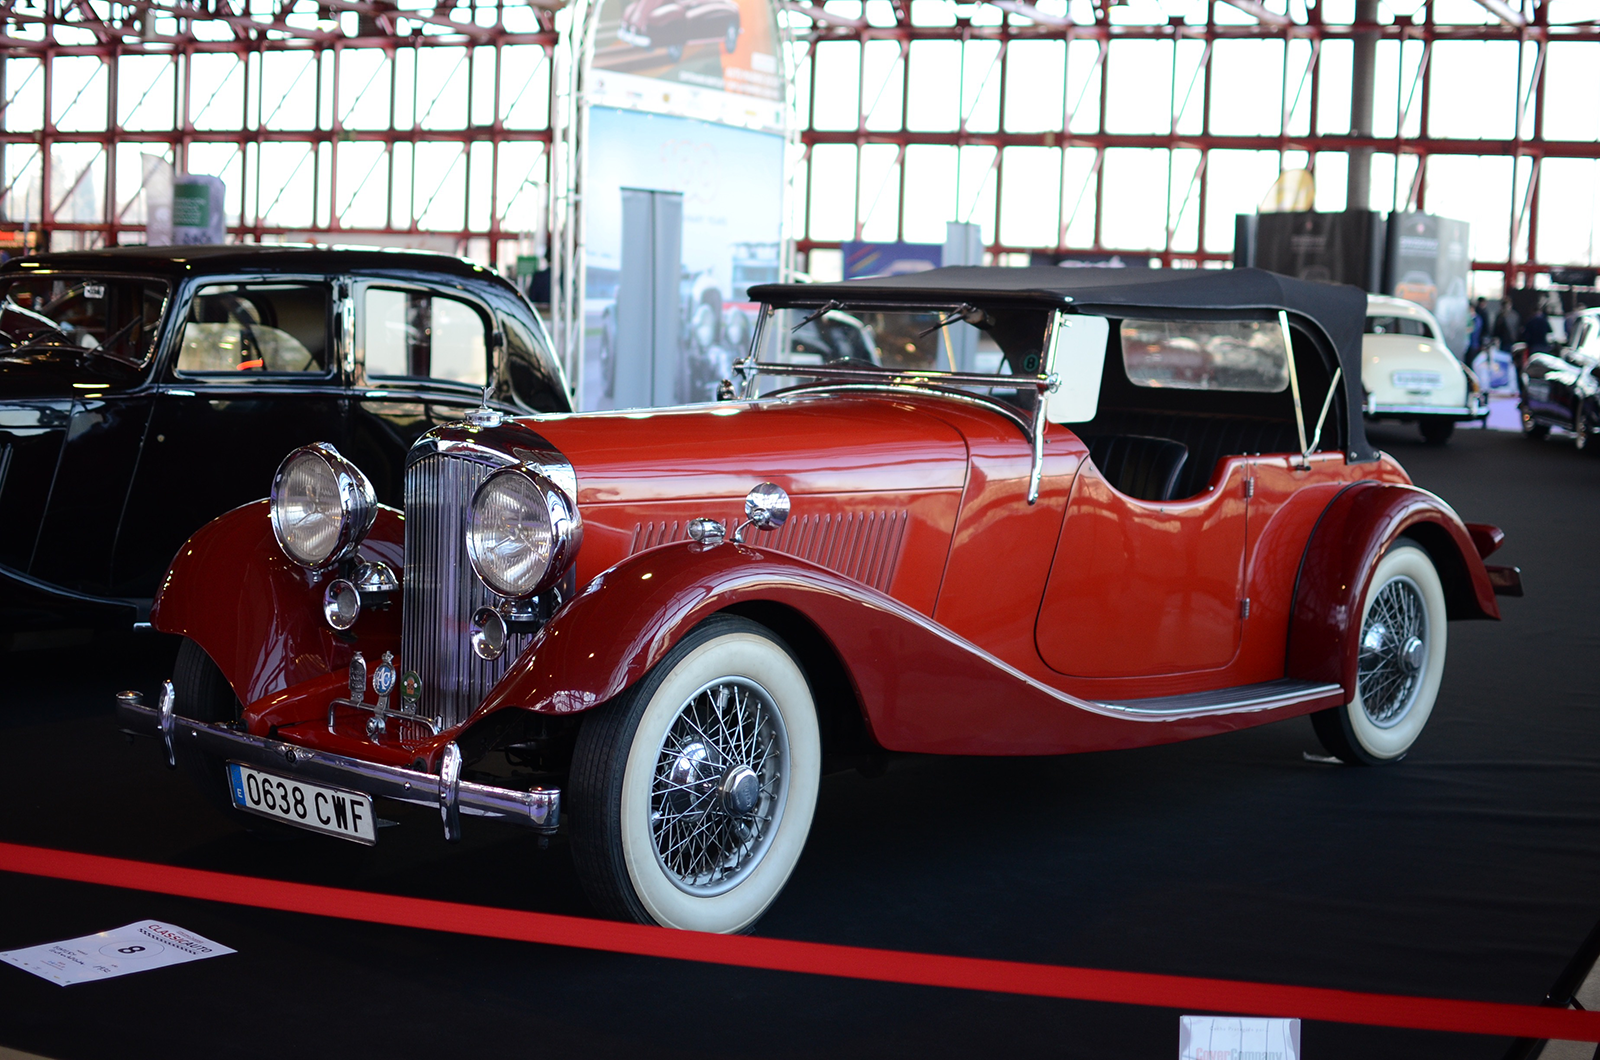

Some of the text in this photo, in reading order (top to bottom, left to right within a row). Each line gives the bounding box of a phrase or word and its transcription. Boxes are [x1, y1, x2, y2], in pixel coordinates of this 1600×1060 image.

[1026, 356, 1036, 369] 8
[236, 788, 243, 798] E
[246, 773, 364, 834] 0638 CWF
[148, 924, 213, 954] CLASSICAUTO
[117, 945, 146, 954] 8
